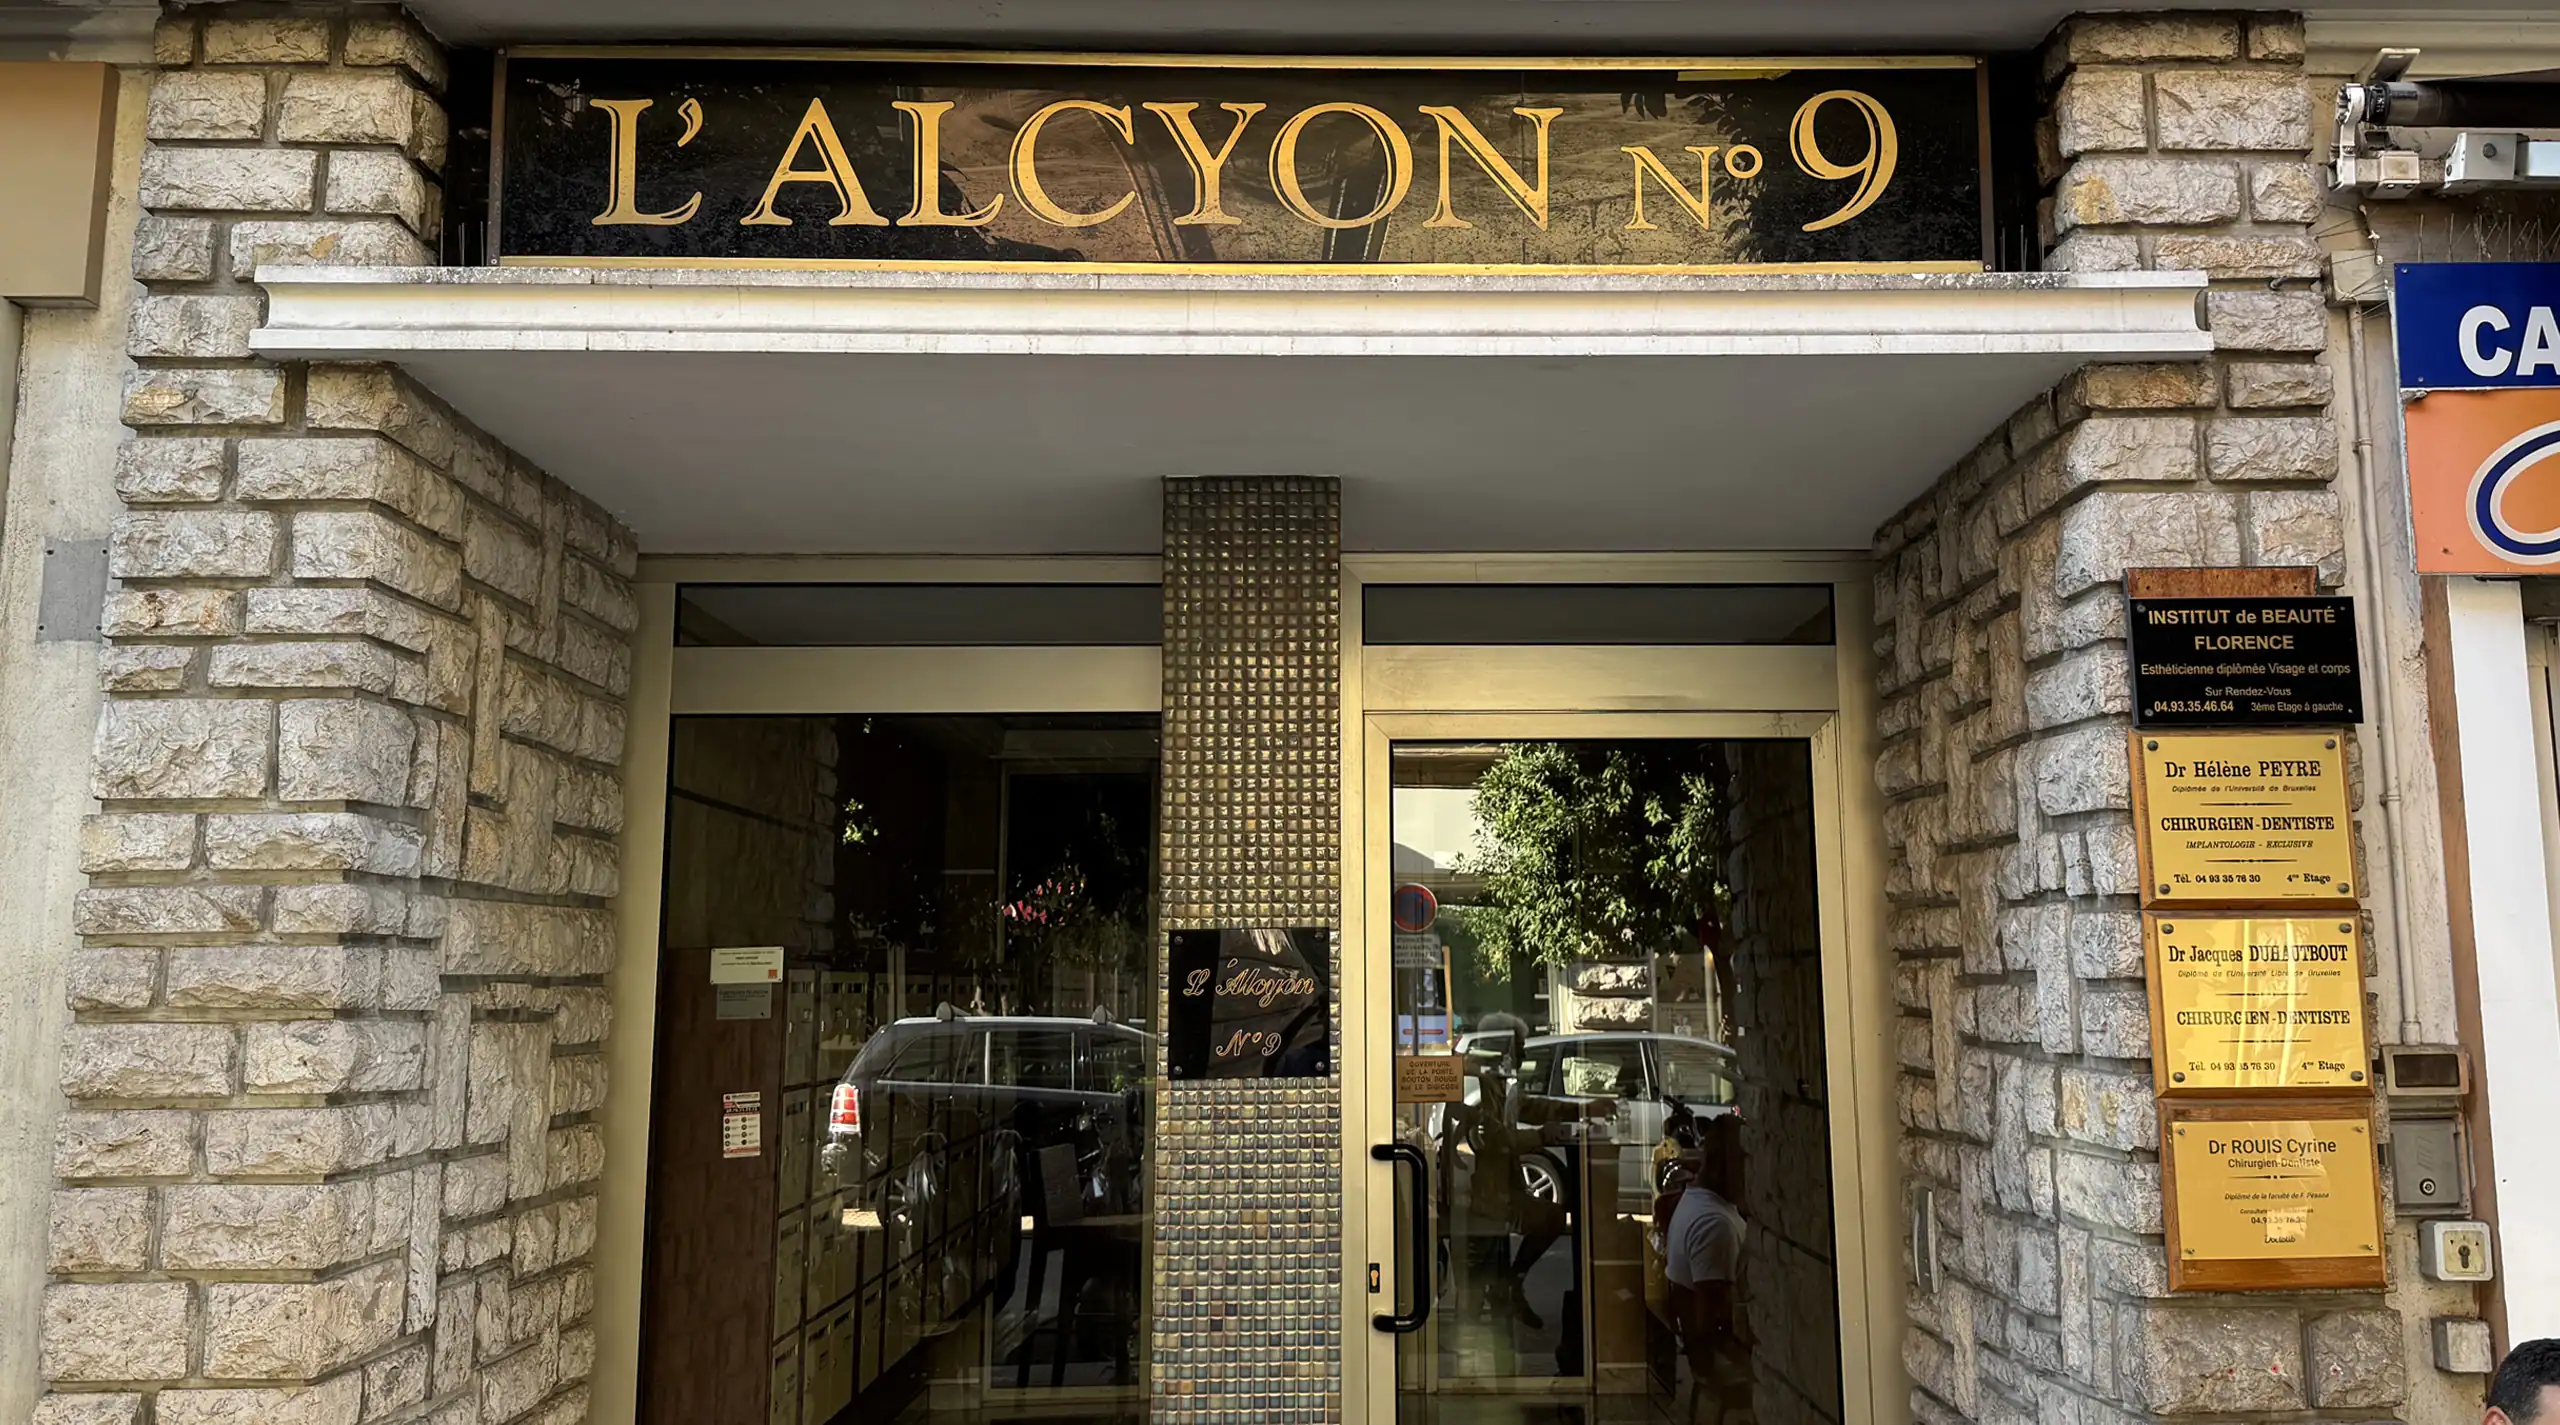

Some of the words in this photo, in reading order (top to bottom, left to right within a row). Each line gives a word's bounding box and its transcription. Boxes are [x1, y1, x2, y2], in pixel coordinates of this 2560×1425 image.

[590, 92, 1564, 232] L'ALCYON
[1789, 89, 1899, 233] 9
[2458, 304, 2560, 378] CA
[2148, 609, 2230, 624] INSTITUT
[2235, 609, 2257, 624] de
[2262, 606, 2336, 624] BEAUTÉ
[2194, 635, 2294, 650] FLORENCE
[2141, 664, 2214, 675] Esthéticienne
[2216, 663, 2266, 677] diplômée
[2268, 663, 2305, 676] Visage
[2308, 664, 2318, 674] et
[2321, 665, 2351, 677] corps
[2205, 686, 2223, 696] Sur
[2225, 686, 2292, 697] Rendez-Vous
[2154, 700, 2234, 713] 04.93.35.46.64
[2277, 702, 2303, 713] Etage
[2304, 701, 2310, 711] à
[2312, 702, 2344, 713] gauche
[2165, 761, 2187, 778] Dr
[2193, 761, 2251, 778] Hélène
[2259, 760, 2321, 777] PEYRE
[2185, 841, 2256, 849] IMPLANTOLOGIE
[2266, 840, 2314, 848] EXCLUSIVE
[2174, 874, 2191, 883] Tél.
[2195, 874, 2207, 883] 04
[2209, 874, 2220, 883] 93
[2222, 874, 2234, 883] 35
[2249, 874, 2261, 883] 30
[2303, 873, 2331, 884] Etage
[2168, 945, 2185, 962] Dr
[2190, 945, 2243, 967] Jacques
[1262, 1032, 1282, 1057] 9
[2210, 1062, 2222, 1071] 04
[2224, 1062, 2236, 1071] 93
[2264, 1062, 2275, 1071] 30
[2318, 1060, 2345, 1072] Etage
[2208, 1139, 2227, 1154] Dr
[2232, 1139, 2282, 1154] ROUIS
[2287, 1139, 2336, 1156] Cyrine
